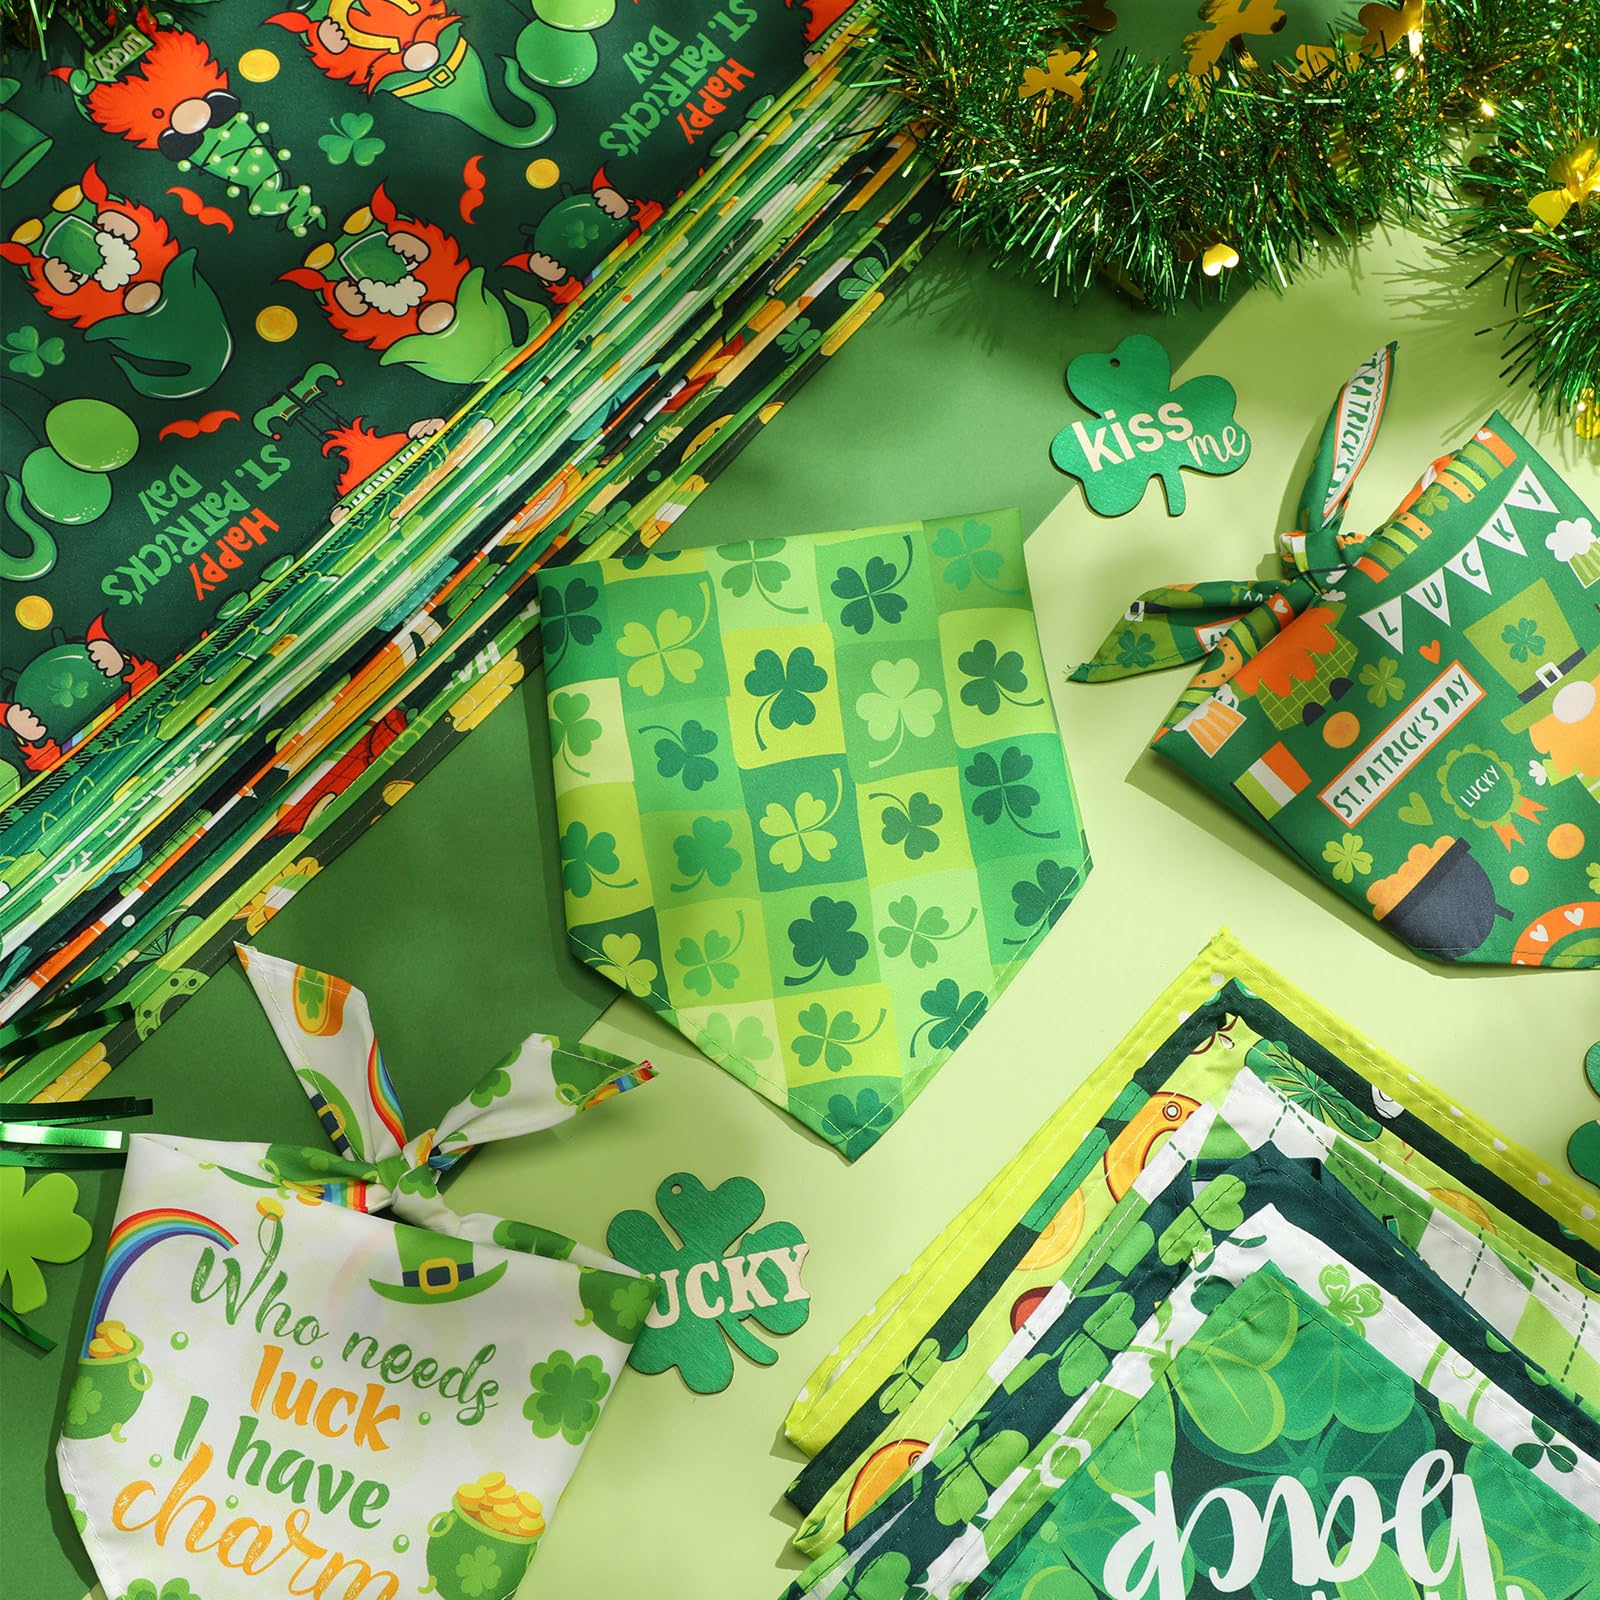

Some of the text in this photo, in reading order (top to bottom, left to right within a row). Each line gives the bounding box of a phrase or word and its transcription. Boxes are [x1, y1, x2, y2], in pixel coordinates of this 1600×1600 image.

[94, 33, 146, 80] LUCKY
[707, 0, 758, 42] ST.
[234, 444, 291, 492] ST.
[1071, 402, 1194, 473] kiss
[1186, 425, 1247, 467] me
[1336, 375, 1376, 475] PATRICK'S
[1332, 674, 1471, 818] ST. PATRICK'S DAY
[1459, 764, 1501, 808] LUCKY
[190, 1212, 500, 1427] Who needs
[644, 1242, 812, 1330] UCKY
[250, 1344, 401, 1452] luck
[173, 1394, 391, 1530] I have
[111, 1440, 401, 1600] charm
[1102, 1448, 1498, 1600] back
